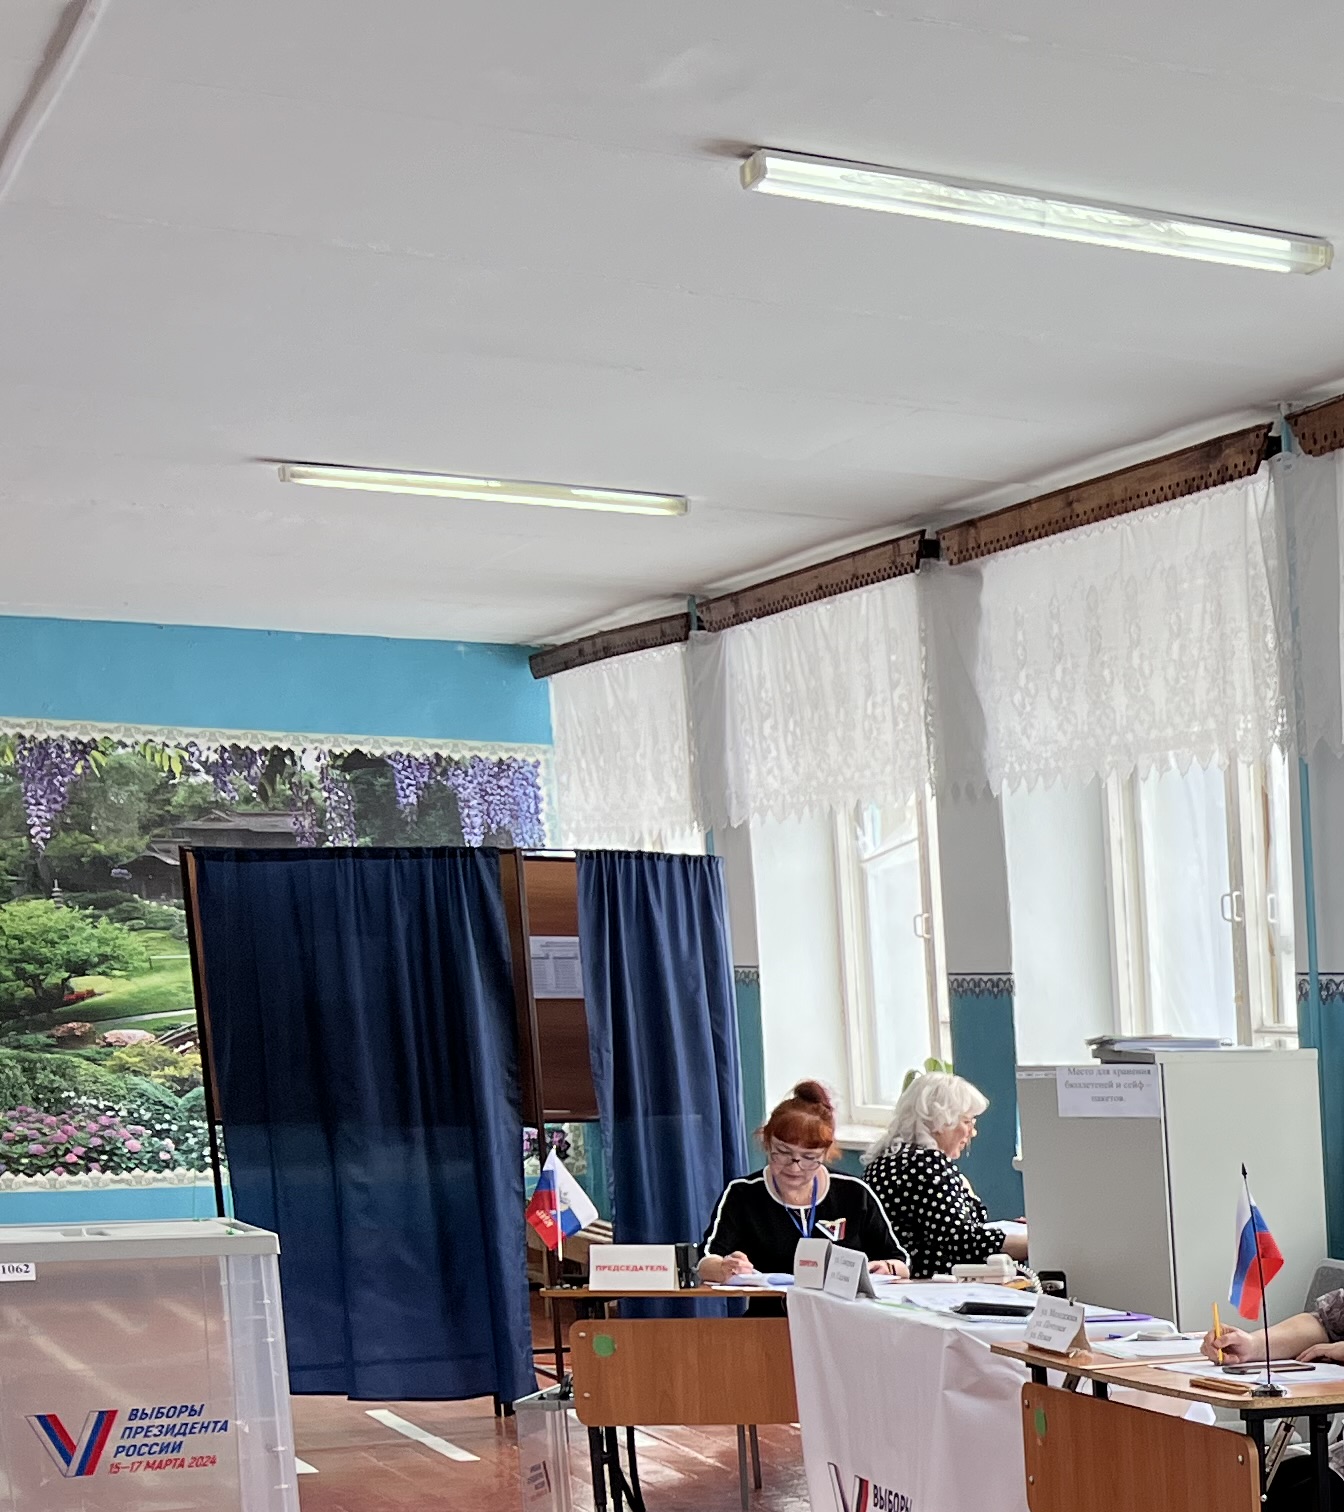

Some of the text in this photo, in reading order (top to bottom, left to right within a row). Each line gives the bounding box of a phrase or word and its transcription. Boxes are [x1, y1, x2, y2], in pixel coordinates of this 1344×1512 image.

[1, 1263, 31, 1274] 1062
[127, 1403, 205, 1421] ВЫБОРЫ
[120, 1419, 229, 1440] ПРЕЗИДЕНТА
[113, 1440, 184, 1459] РОССИИ
[144, 1457, 186, 1472] МАРТА
[188, 1454, 217, 1469] 2024
